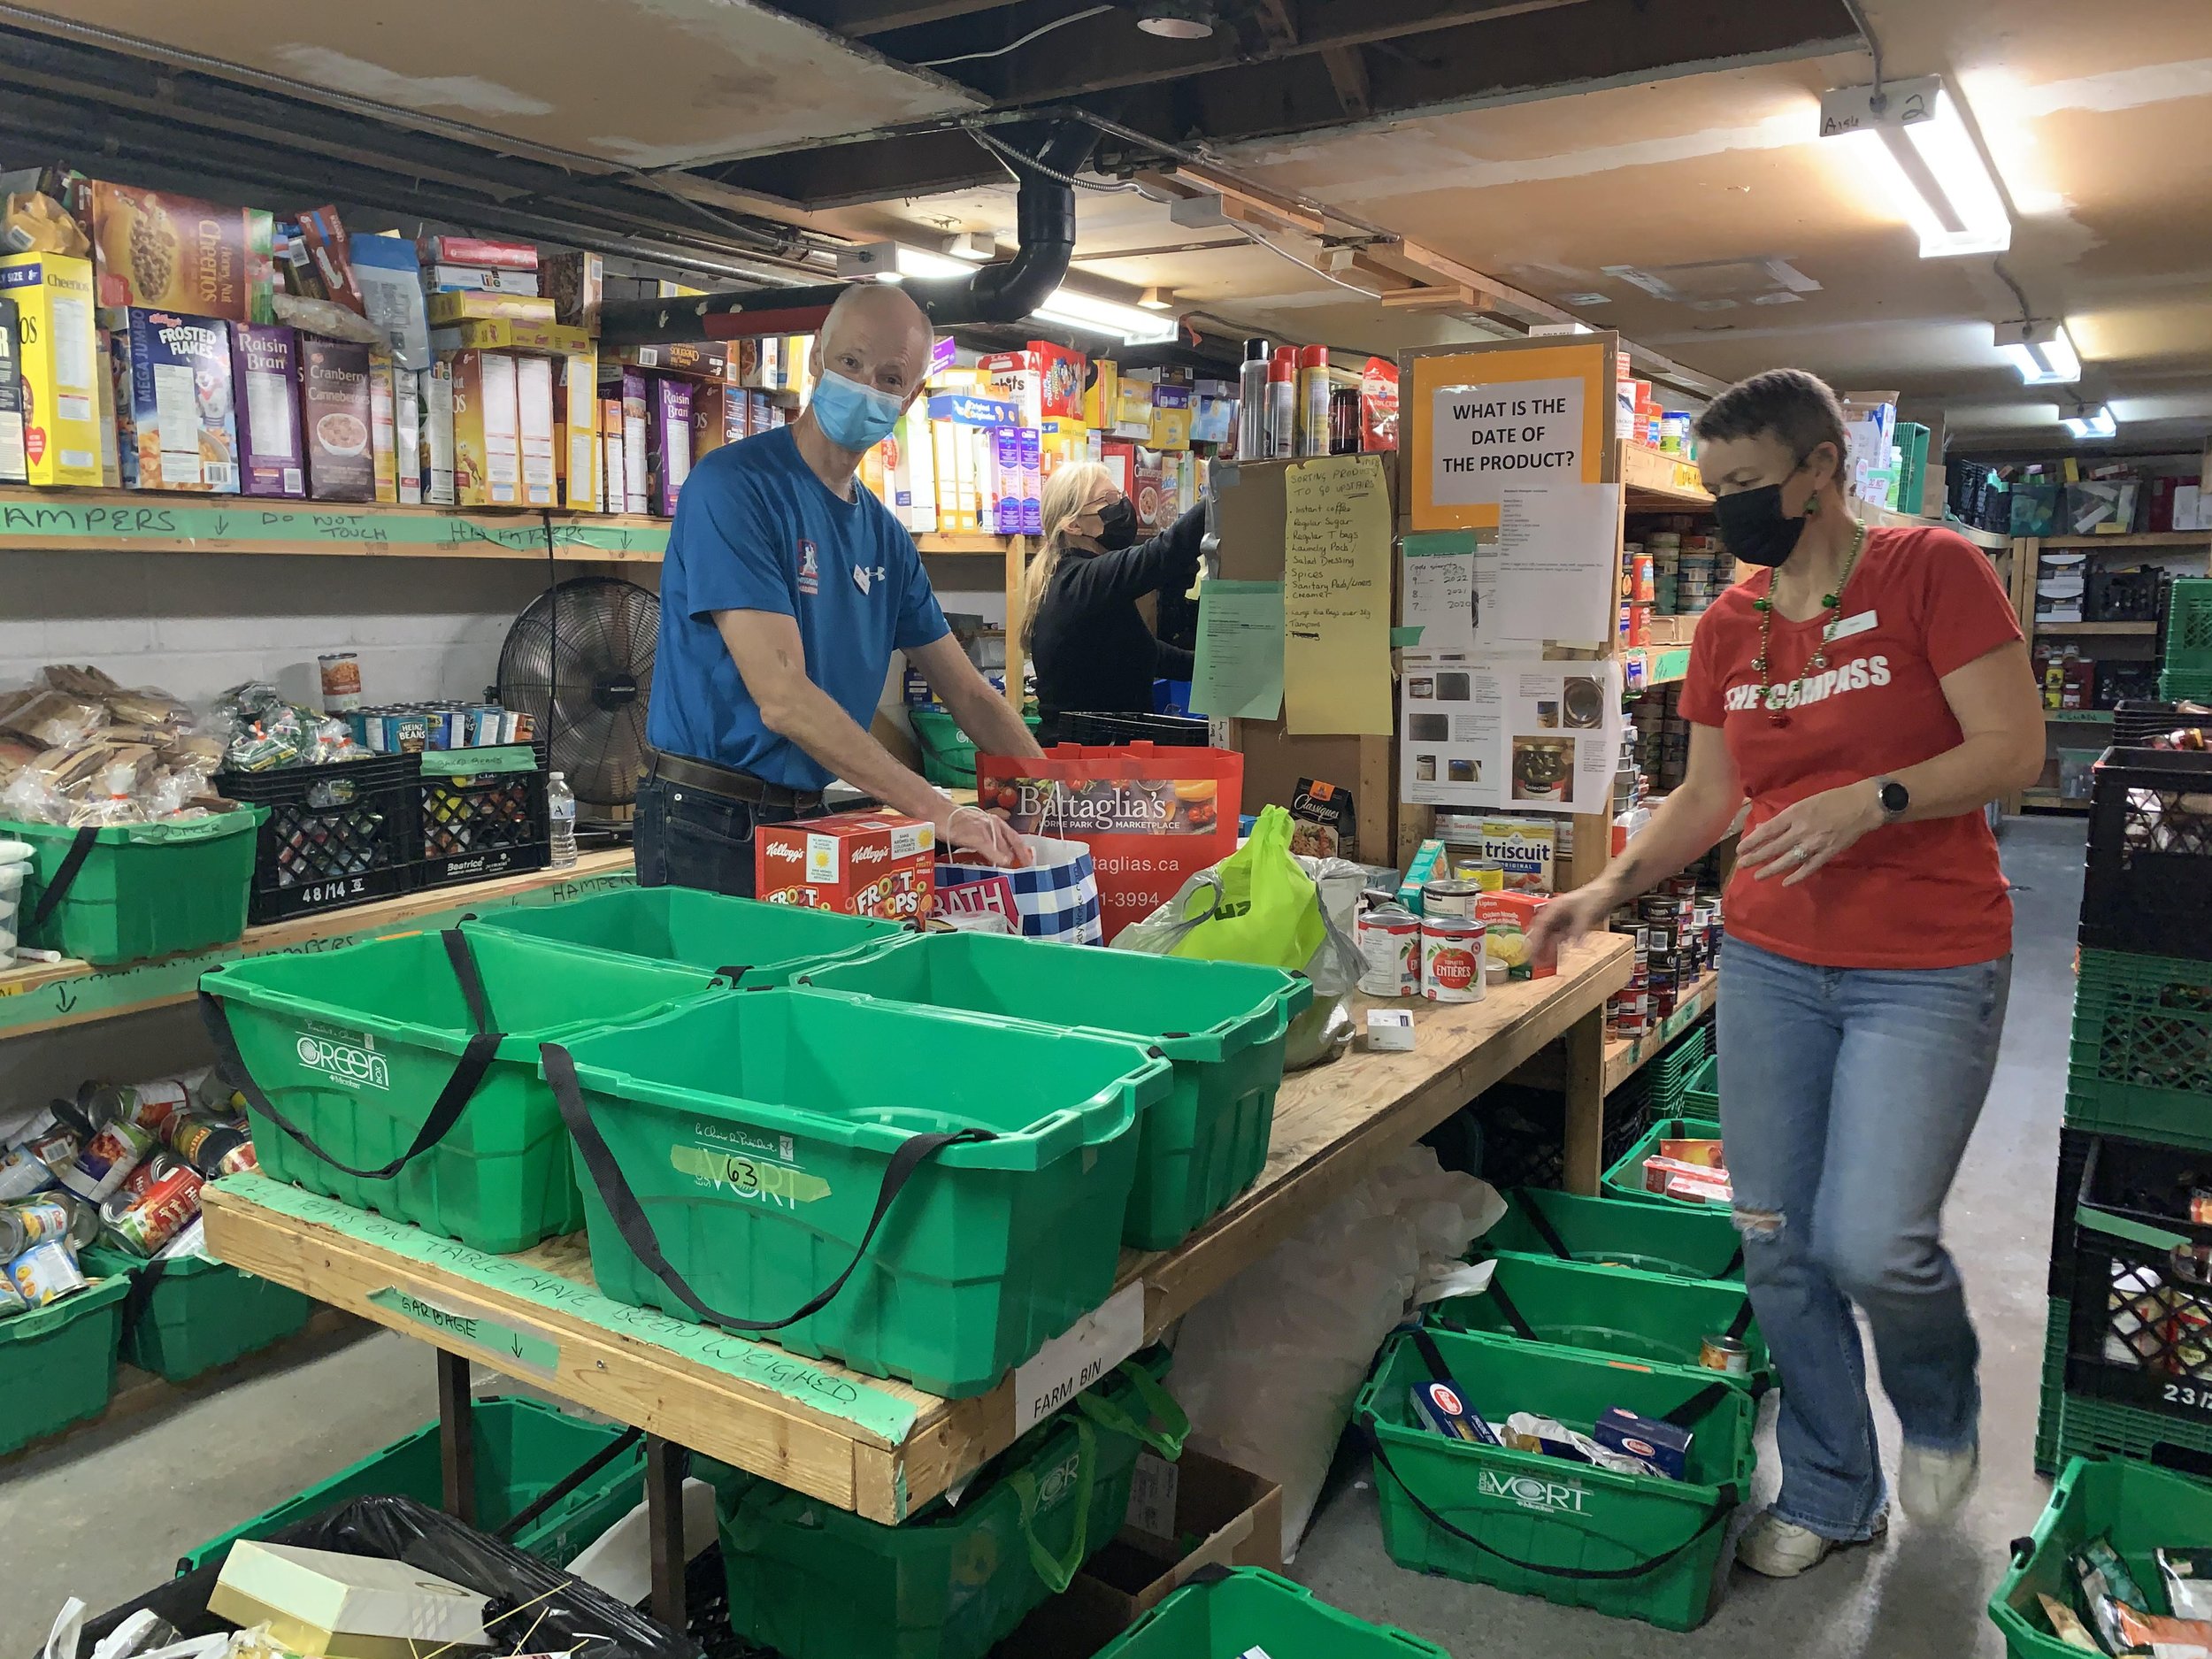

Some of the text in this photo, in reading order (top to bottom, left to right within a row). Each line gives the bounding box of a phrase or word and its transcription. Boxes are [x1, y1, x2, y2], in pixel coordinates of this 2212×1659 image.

[1824, 93, 1928, 134] Aisle 2
[198, 219, 221, 303] Cheerios
[8, 272, 23, 283] SIZE
[47, 273, 89, 292] Cheerios
[158, 326, 217, 345] FROSTED
[238, 334, 288, 354] Raisin
[134, 310, 151, 402] MEGA JUMBO
[170, 342, 213, 359] FLAKES
[248, 354, 285, 370] Bran
[310, 365, 368, 384] Cranberry
[664, 388, 689, 405] Raisin
[667, 403, 688, 419] Bran
[1453, 398, 1566, 419] WHAT IS THE
[1471, 426, 1546, 445] DATE OF
[1443, 450, 1575, 473] THE PRODUCT?
[1290, 472, 1326, 484] SORTING
[1294, 480, 1375, 496] TO GO UPSTAIRS
[1295, 501, 1351, 514] Instant coffee
[262, 511, 294, 526] DO
[313, 515, 364, 526] NOT
[1294, 517, 1353, 531] Regular Sugar
[320, 527, 388, 541] TOUCH
[1293, 530, 1324, 544] Regular
[1339, 529, 1359, 543] bags
[1293, 556, 1355, 568] Salad Dressing
[1291, 568, 1324, 581] Spices
[1443, 574, 1469, 584] 2022
[1292, 580, 1329, 592] Sanitary
[1764, 654, 1892, 710] COMPASS
[399, 730, 426, 741] BEANS
[402, 722, 424, 733] HEINZ
[1018, 785, 1167, 830] Battaglia's
[1294, 793, 1340, 821] Classiques
[1069, 819, 1094, 829] PARK
[1115, 819, 1180, 830] MARKETPLACE
[765, 841, 806, 864] Kellogg's
[850, 844, 891, 864] Kellogg's
[1485, 841, 1551, 861] triscuit
[447, 859, 483, 872] Beatrice
[1093, 855, 1179, 875] taglias.ca
[856, 870, 914, 915] FROOT
[933, 882, 1000, 918] BATH
[1100, 892, 1160, 908] 1-3994
[1479, 899, 1498, 908] Lipton
[1436, 965, 1471, 978] ENTIÈRES
[374, 1064, 383, 1085] BOX
[726, 1158, 758, 1187] 63
[401, 1296, 480, 1340] GARBAGE
[426, 1240, 519, 1274] TABLE
[512, 1274, 595, 1309] HAVE
[703, 1338, 857, 1405] WEIGHED
[1033, 1357, 1102, 1419] FARM BIN
